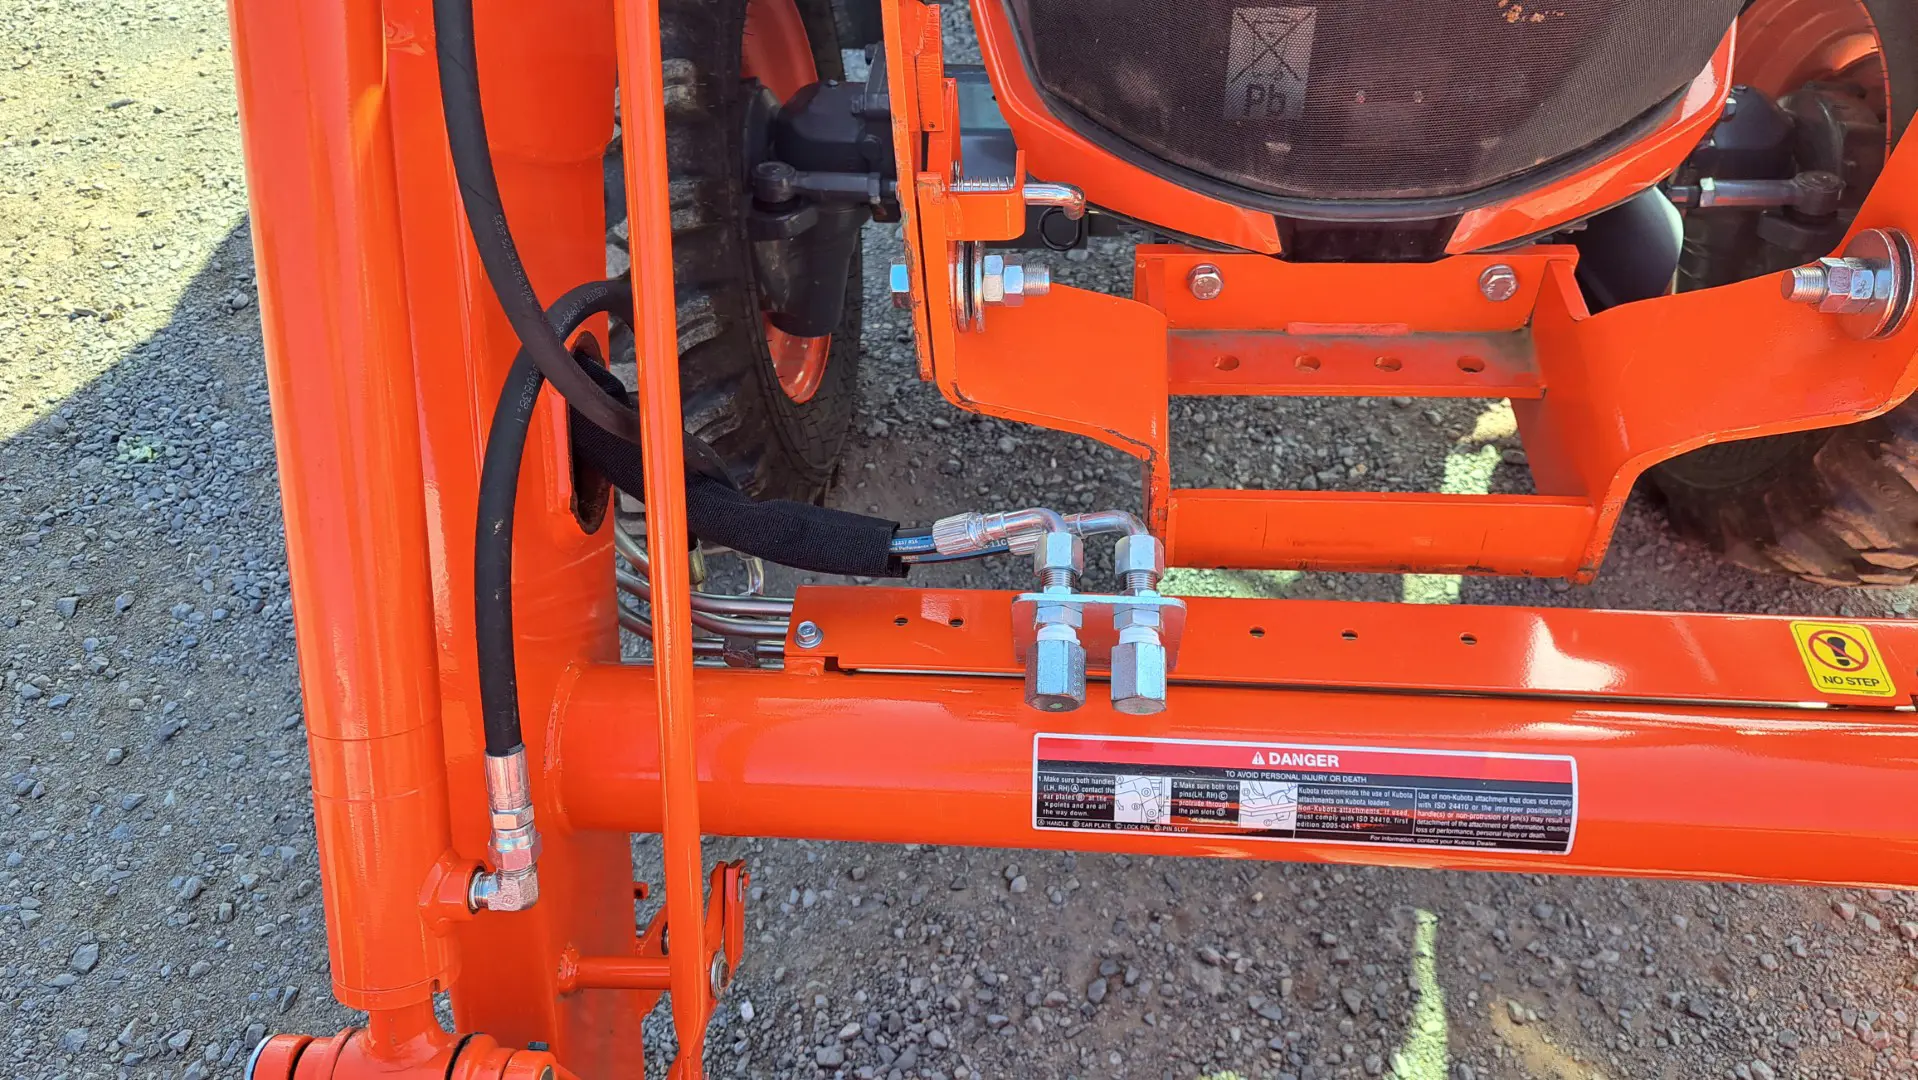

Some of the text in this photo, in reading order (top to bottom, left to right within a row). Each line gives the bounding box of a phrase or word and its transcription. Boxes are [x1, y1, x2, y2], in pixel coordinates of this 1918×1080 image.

[1244, 84, 1286, 116] Pb
[1822, 675, 1880, 687] NO STEP
[1269, 752, 1339, 768] DANGER
[1237, 771, 1258, 779] AVOID
[1261, 773, 1300, 781] PERSONAL
[1055, 794, 1075, 802] plates
[1298, 796, 1334, 804] attachments
[1392, 791, 1413, 799] Kubota
[1439, 793, 1473, 801] non-Kubota
[1475, 795, 1508, 803] attachment
[1509, 796, 1521, 804] that
[1522, 796, 1537, 805] does
[1538, 797, 1548, 805] not
[1550, 798, 1572, 807] comply
[1179, 800, 1204, 808] protrude
[1298, 805, 1337, 813] Non-Kubota
[1494, 805, 1523, 814] improper
[1526, 807, 1562, 815] positioning
[1315, 814, 1339, 822] comply
[1417, 810, 1445, 819] handle(s)
[1456, 813, 1501, 821] non-protrusion
[1416, 819, 1450, 827] detachment
[1469, 821, 1500, 829] attachment
[1547, 825, 1569, 833] causing
[1476, 830, 1502, 838] personal
